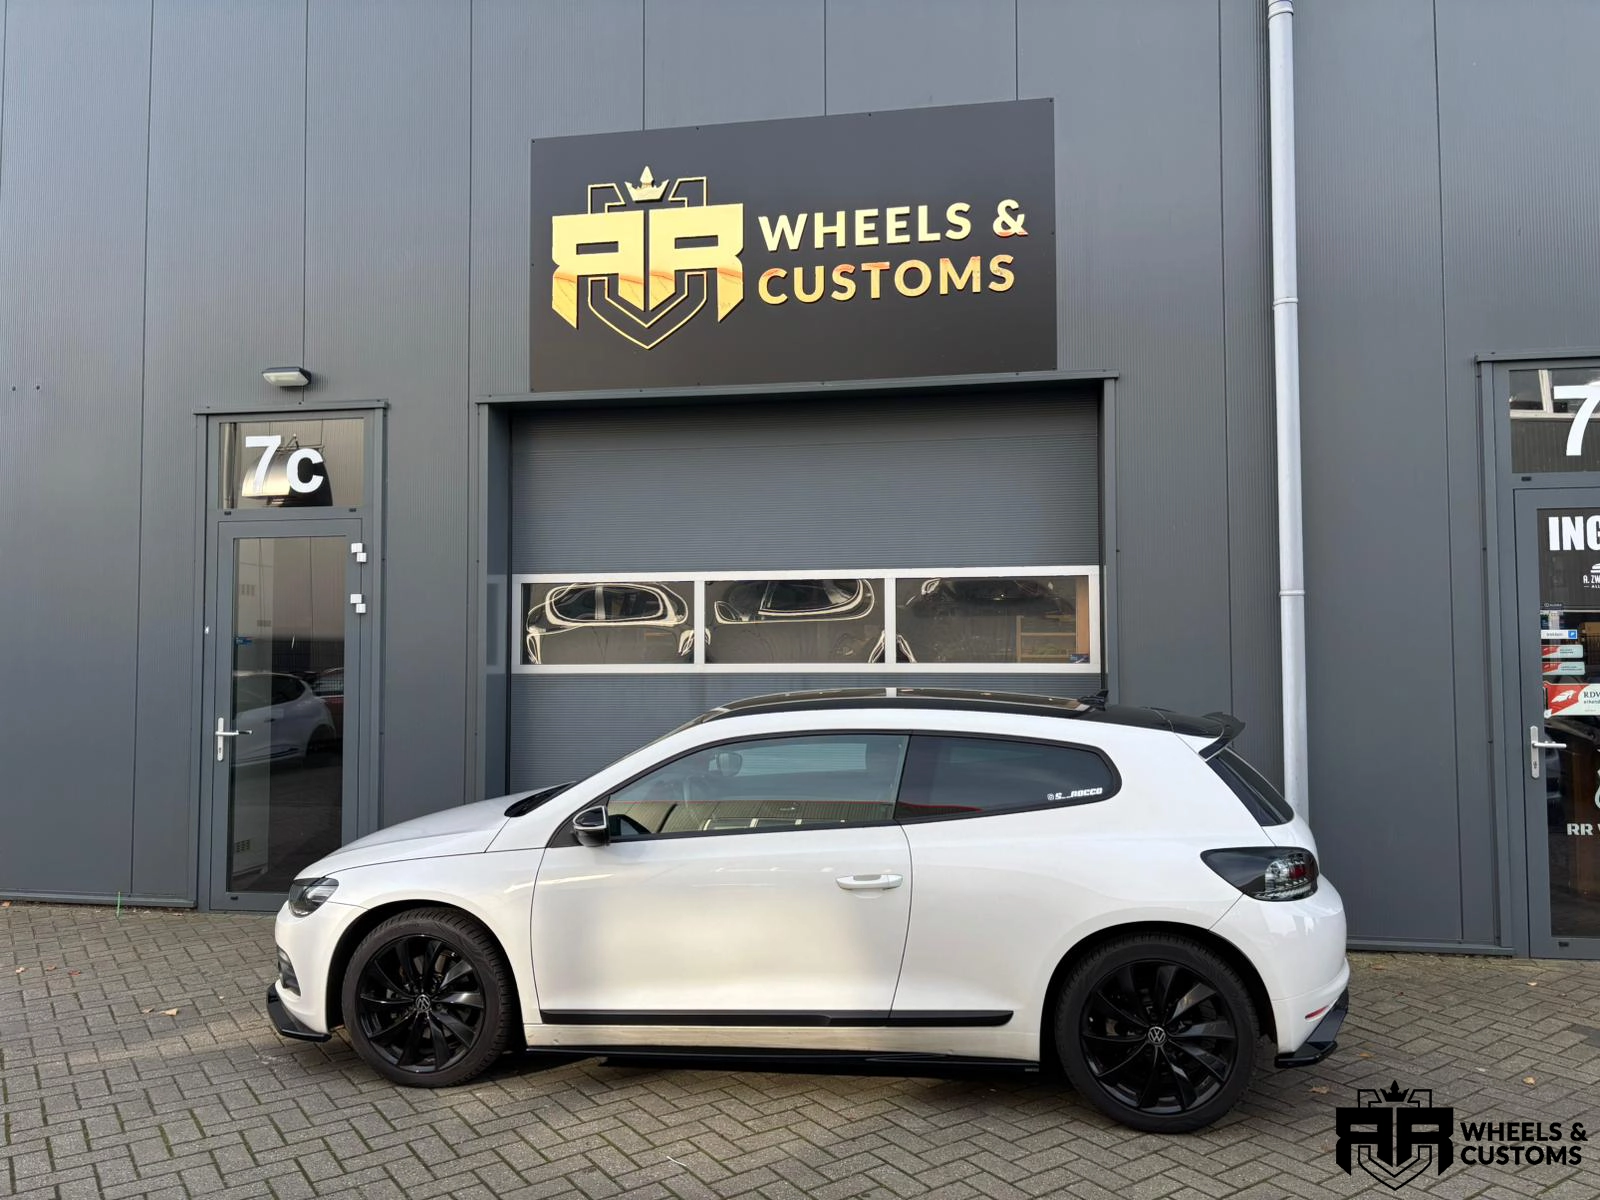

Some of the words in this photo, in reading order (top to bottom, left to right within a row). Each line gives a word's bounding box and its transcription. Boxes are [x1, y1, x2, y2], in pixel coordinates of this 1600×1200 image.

[757, 202, 972, 252] WHEELS
[991, 198, 1029, 238] &
[757, 253, 1016, 305] CUSTOMS
[1566, 823, 1594, 836] RR
